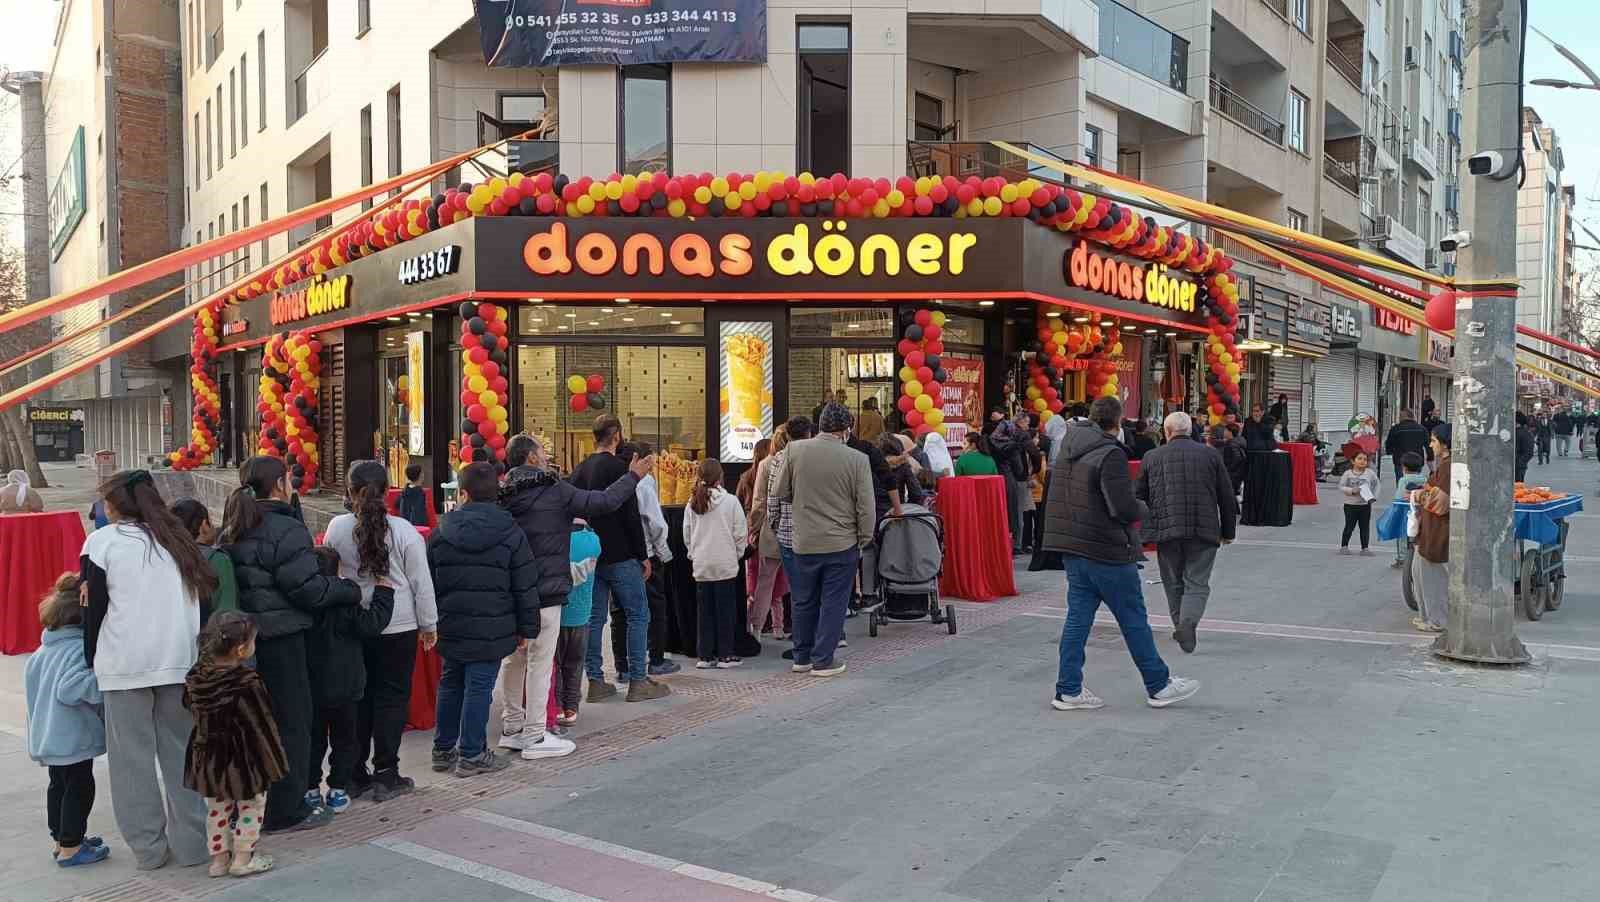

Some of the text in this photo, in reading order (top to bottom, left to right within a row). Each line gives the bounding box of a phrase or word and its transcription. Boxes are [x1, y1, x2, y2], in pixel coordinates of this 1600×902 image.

[515, 15, 524, 26] 0
[527, 15, 551, 26] 541
[580, 12, 598, 23] 32
[602, 12, 619, 25] 35
[632, 15, 641, 25] 0
[644, 11, 669, 25] 533
[671, 10, 699, 22] 344
[703, 10, 718, 22] 41
[721, 11, 737, 23] 13
[398, 246, 453, 285] 444 33 67
[523, 220, 977, 277] donas döner
[271, 273, 348, 326] donas döner
[1070, 240, 1198, 313] donas döner
[740, 441, 754, 450] 140
